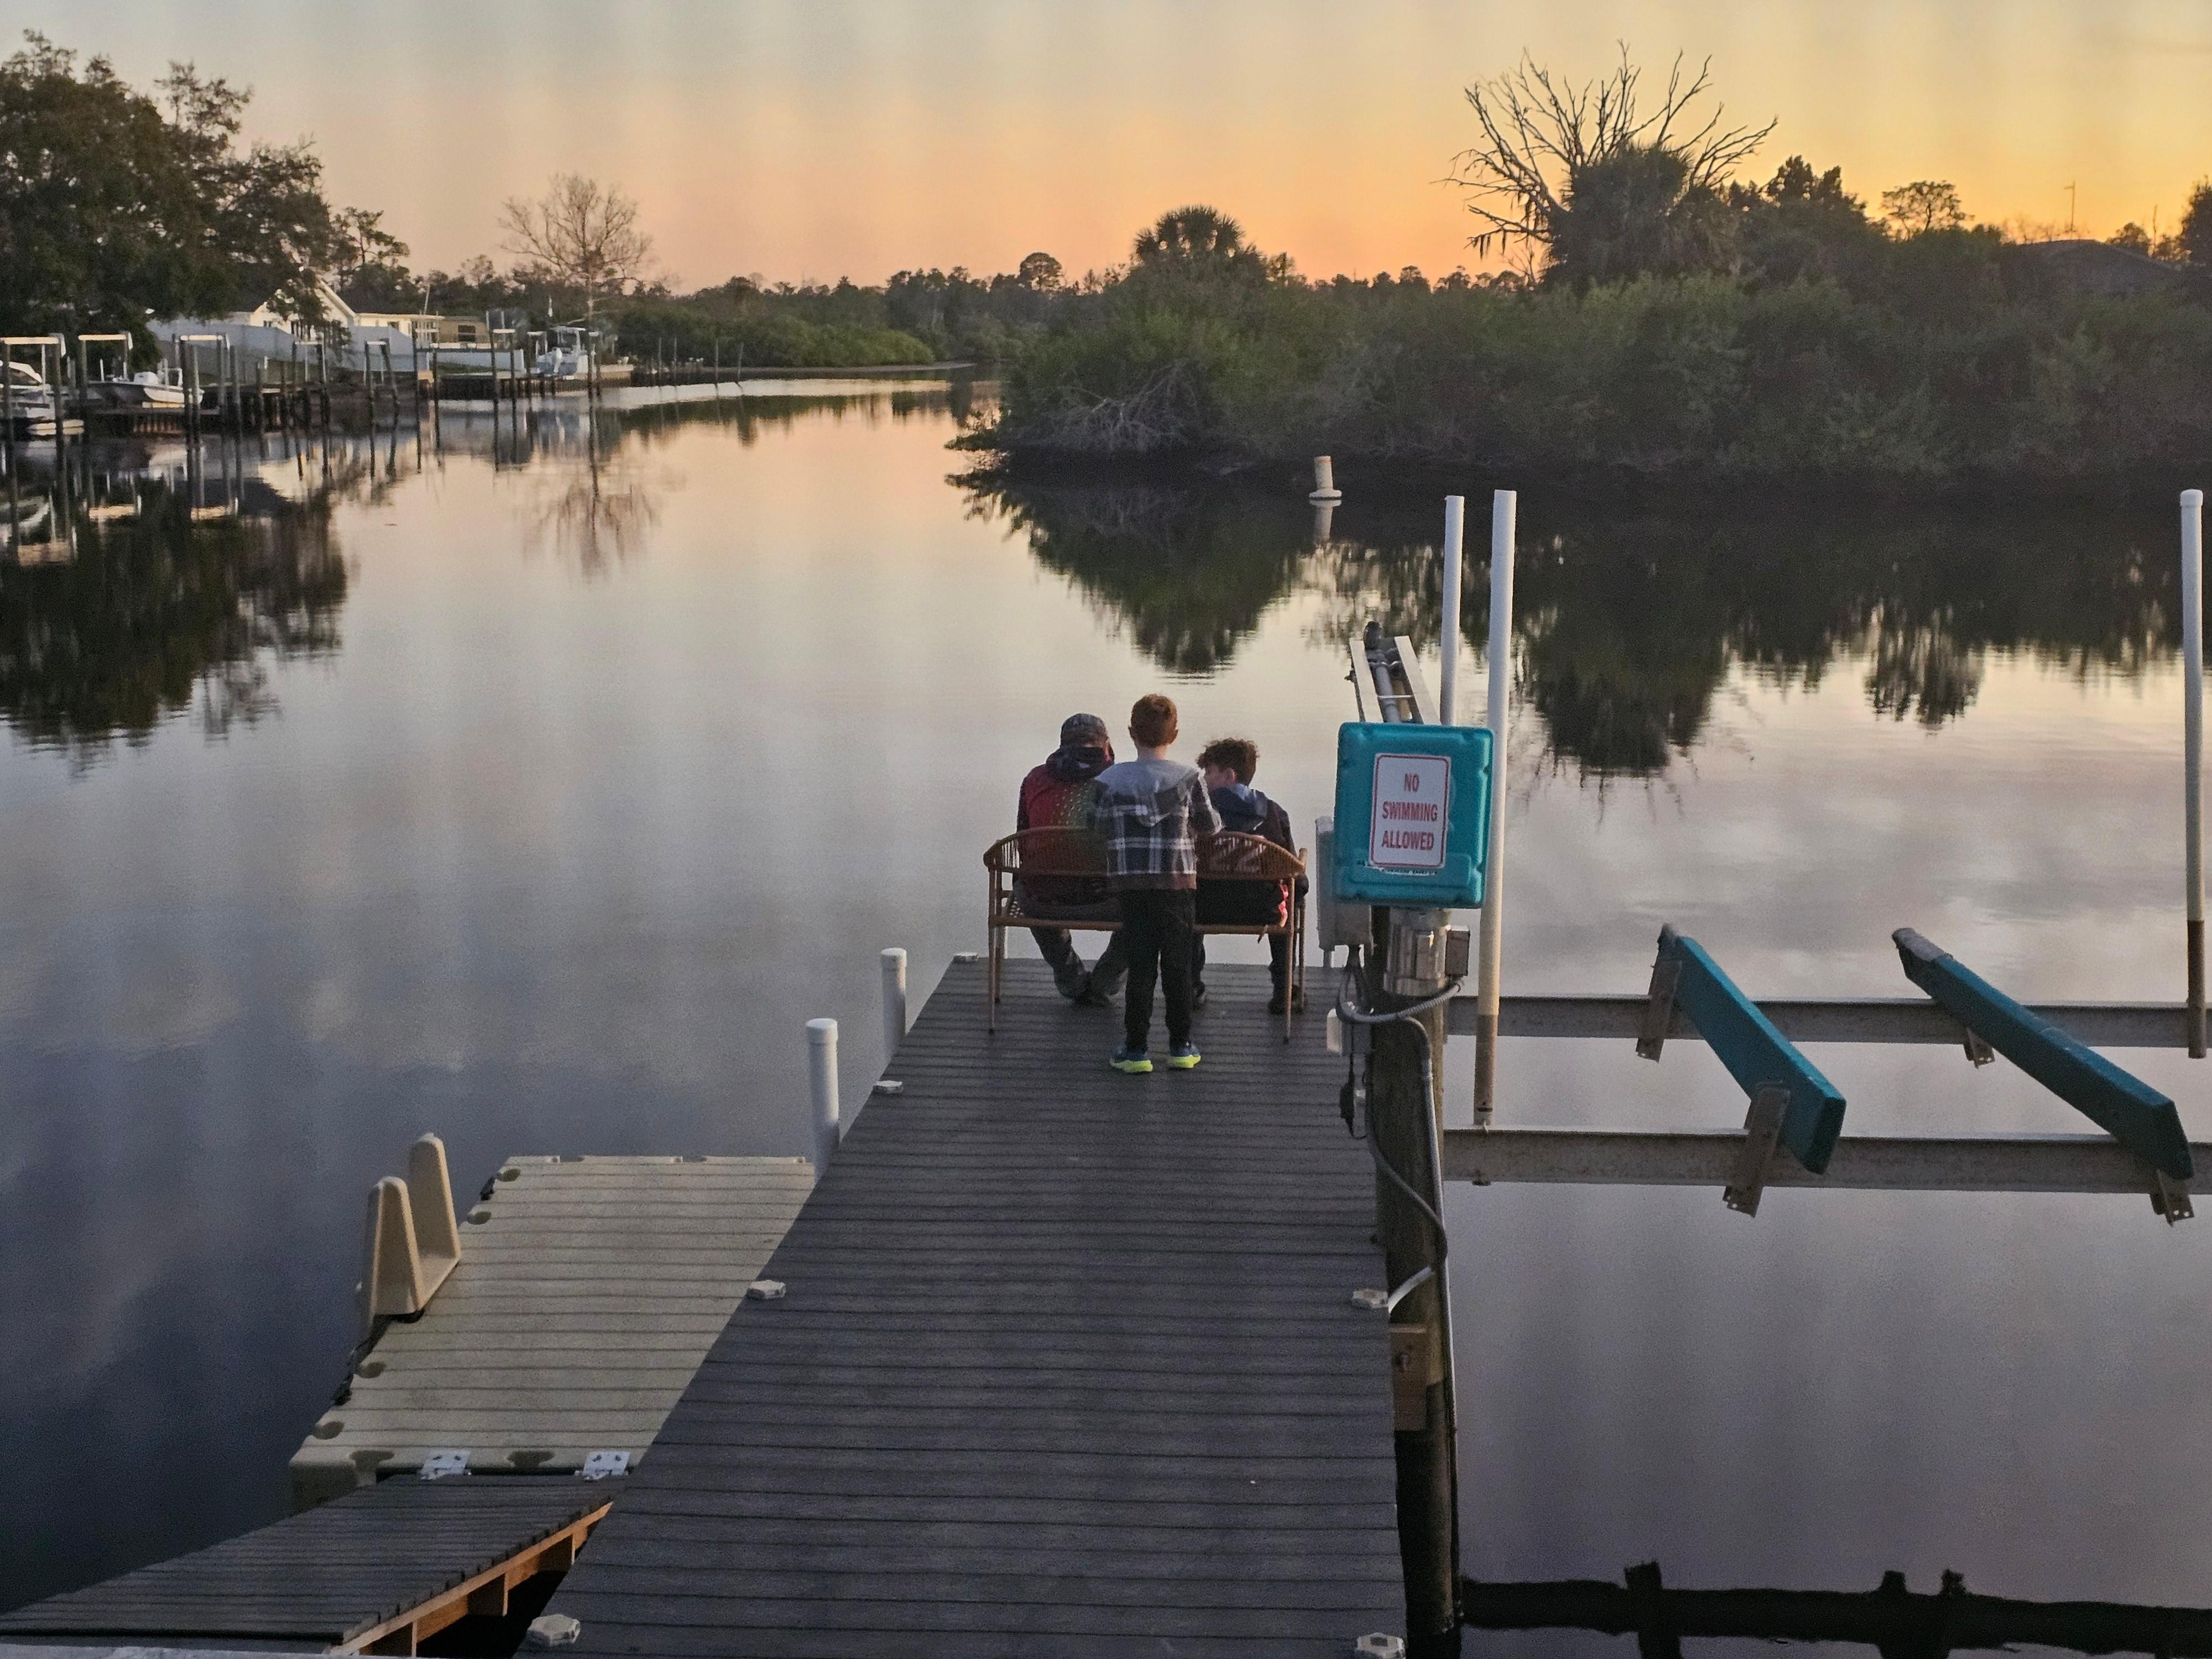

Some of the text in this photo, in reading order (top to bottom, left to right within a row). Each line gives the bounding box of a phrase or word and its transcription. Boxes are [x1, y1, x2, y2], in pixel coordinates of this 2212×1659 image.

[1404, 773, 1420, 792] NO
[1382, 801, 1438, 822] SWIMMING
[1381, 830, 1434, 851] ALLOWED
